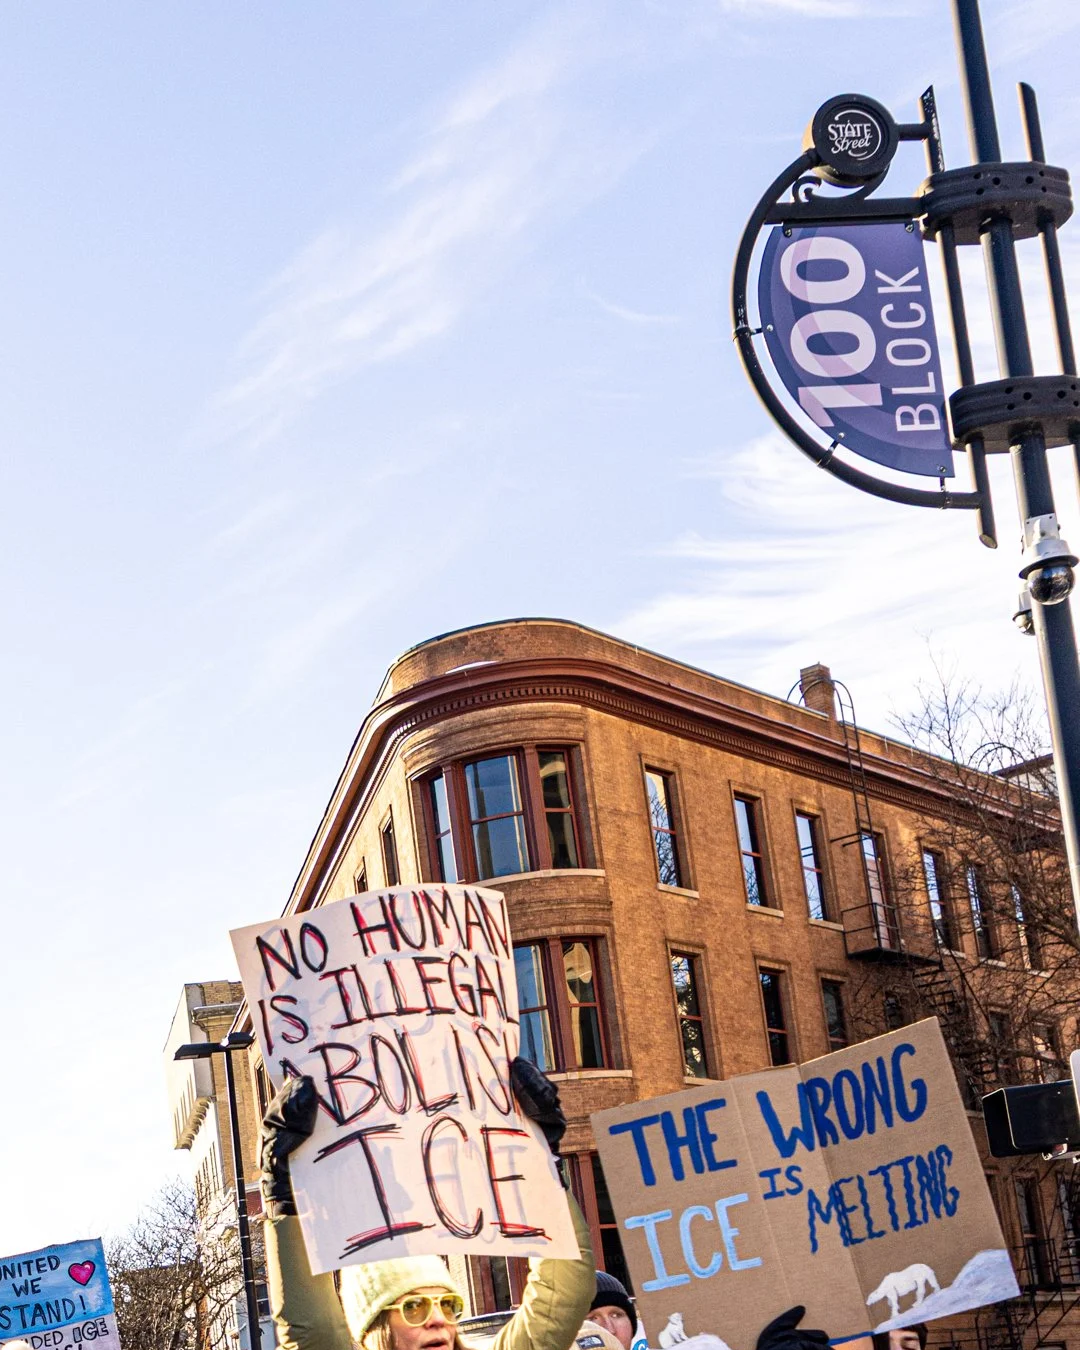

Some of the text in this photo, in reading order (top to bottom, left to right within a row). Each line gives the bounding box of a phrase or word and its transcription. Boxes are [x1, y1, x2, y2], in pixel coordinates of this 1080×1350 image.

[828, 121, 871, 140] STATE
[831, 133, 873, 154] Street
[780, 236, 883, 428] 100
[875, 266, 941, 432] BLOCK
[256, 886, 511, 991] NO HUMAN
[258, 951, 520, 1056] IS ILLEGAL
[609, 1043, 928, 1186] THE WRONG
[313, 1114, 552, 1259] ICE
[624, 1144, 960, 1291] ICE IS MELTING
[12, 1277, 42, 1298] WE
[72, 1317, 109, 1344] ICE
